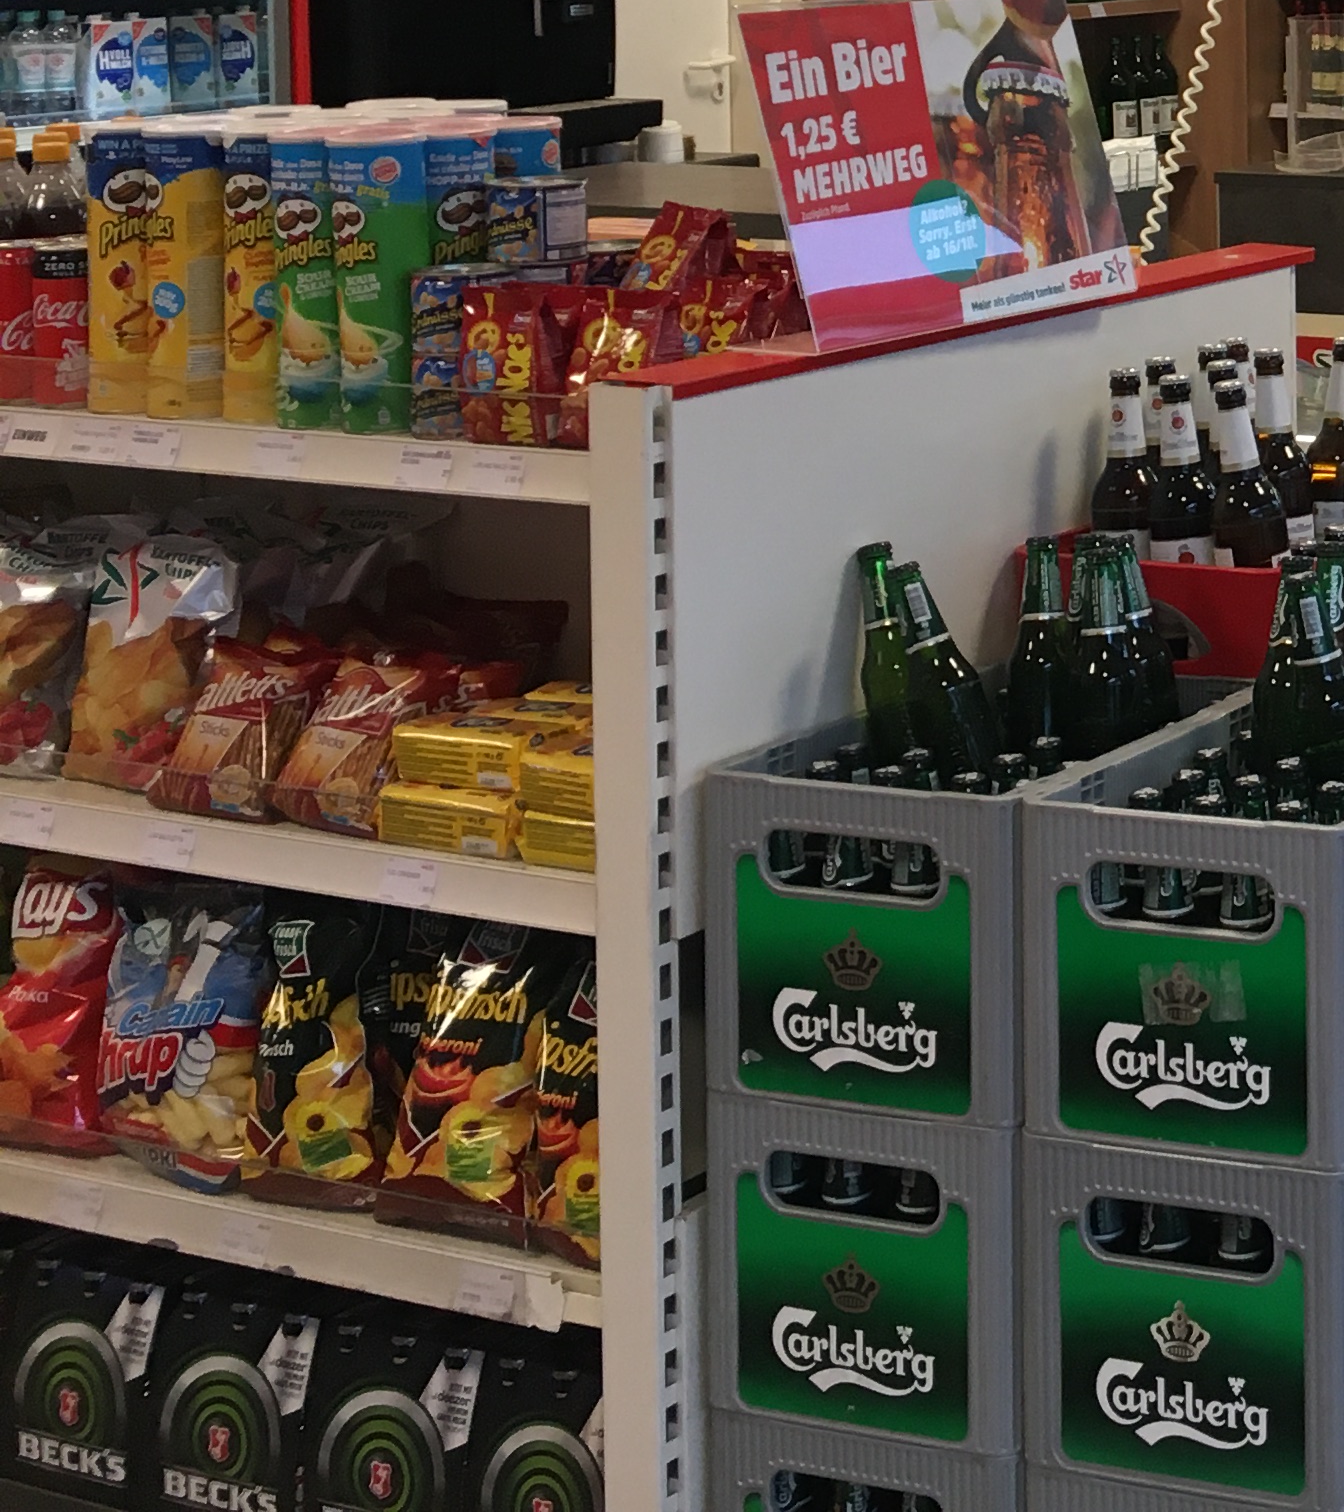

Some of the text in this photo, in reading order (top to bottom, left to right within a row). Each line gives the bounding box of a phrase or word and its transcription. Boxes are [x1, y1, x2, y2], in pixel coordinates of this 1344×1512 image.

[764, 37, 907, 104] Ein Bier
[781, 111, 861, 161] 1,25 €
[794, 145, 927, 204] MEHRWEG
[1069, 269, 1102, 291] star
[196, 672, 292, 712] altletts
[772, 987, 938, 1072] Carlsberg
[1095, 1021, 1272, 1110] Carlsberg
[772, 1305, 935, 1394] Carlsberg
[1095, 1358, 1269, 1448] Carlsberg
[16, 1430, 127, 1481] BECK'S
